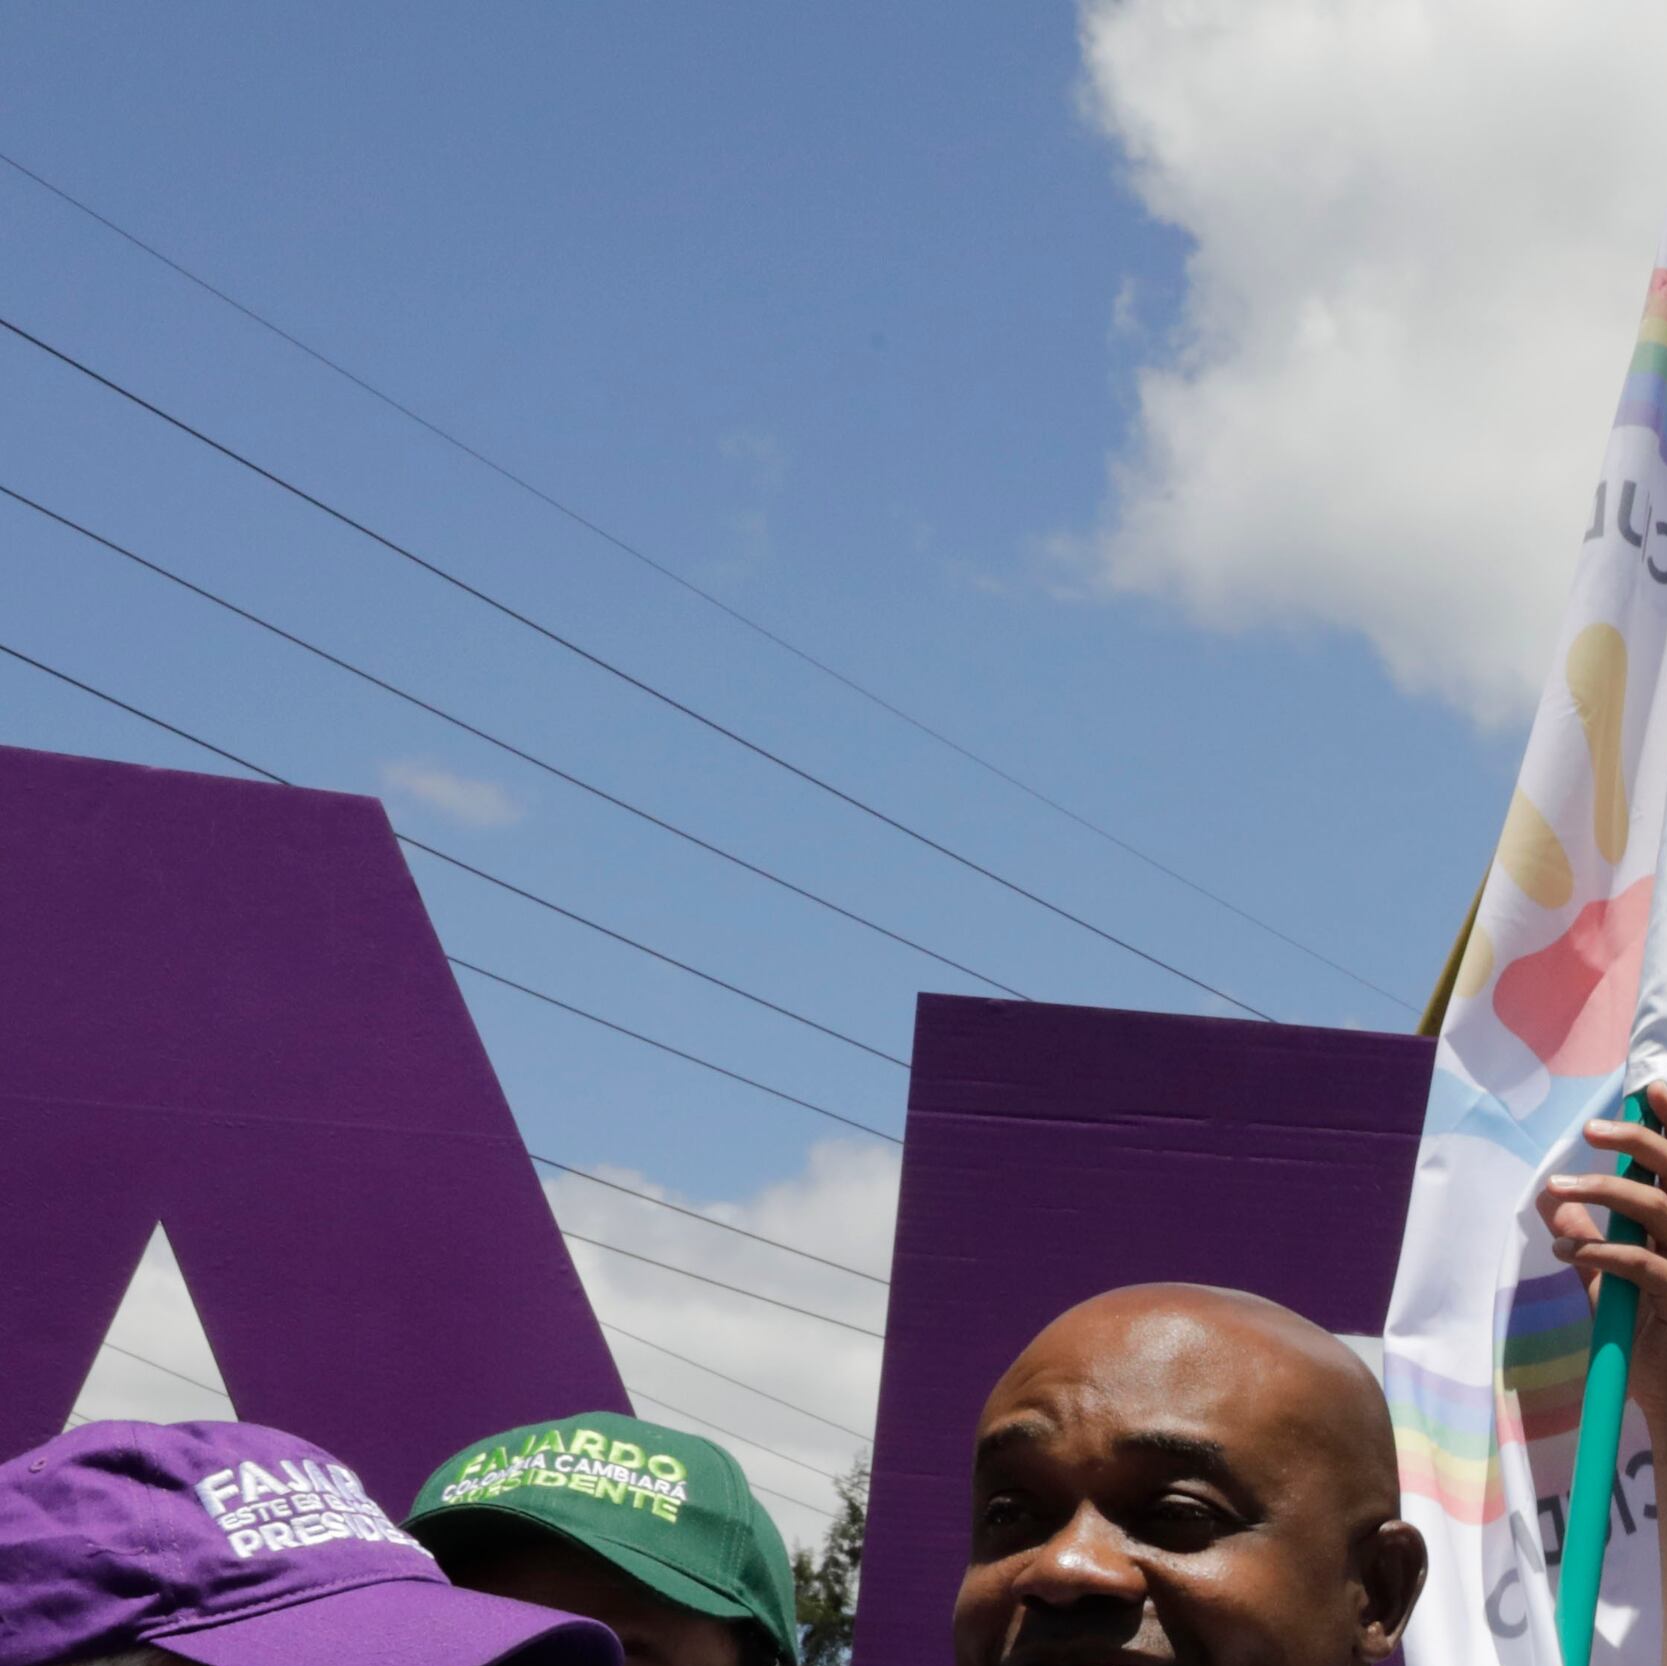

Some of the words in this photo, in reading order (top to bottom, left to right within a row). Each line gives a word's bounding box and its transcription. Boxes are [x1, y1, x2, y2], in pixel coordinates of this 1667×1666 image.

[456, 1428, 688, 1483] FAJARDO
[554, 1454, 688, 1500] CAMBIARÁ
[217, 1498, 293, 1531] ESTE
[228, 1511, 435, 1560] PRESIDE
